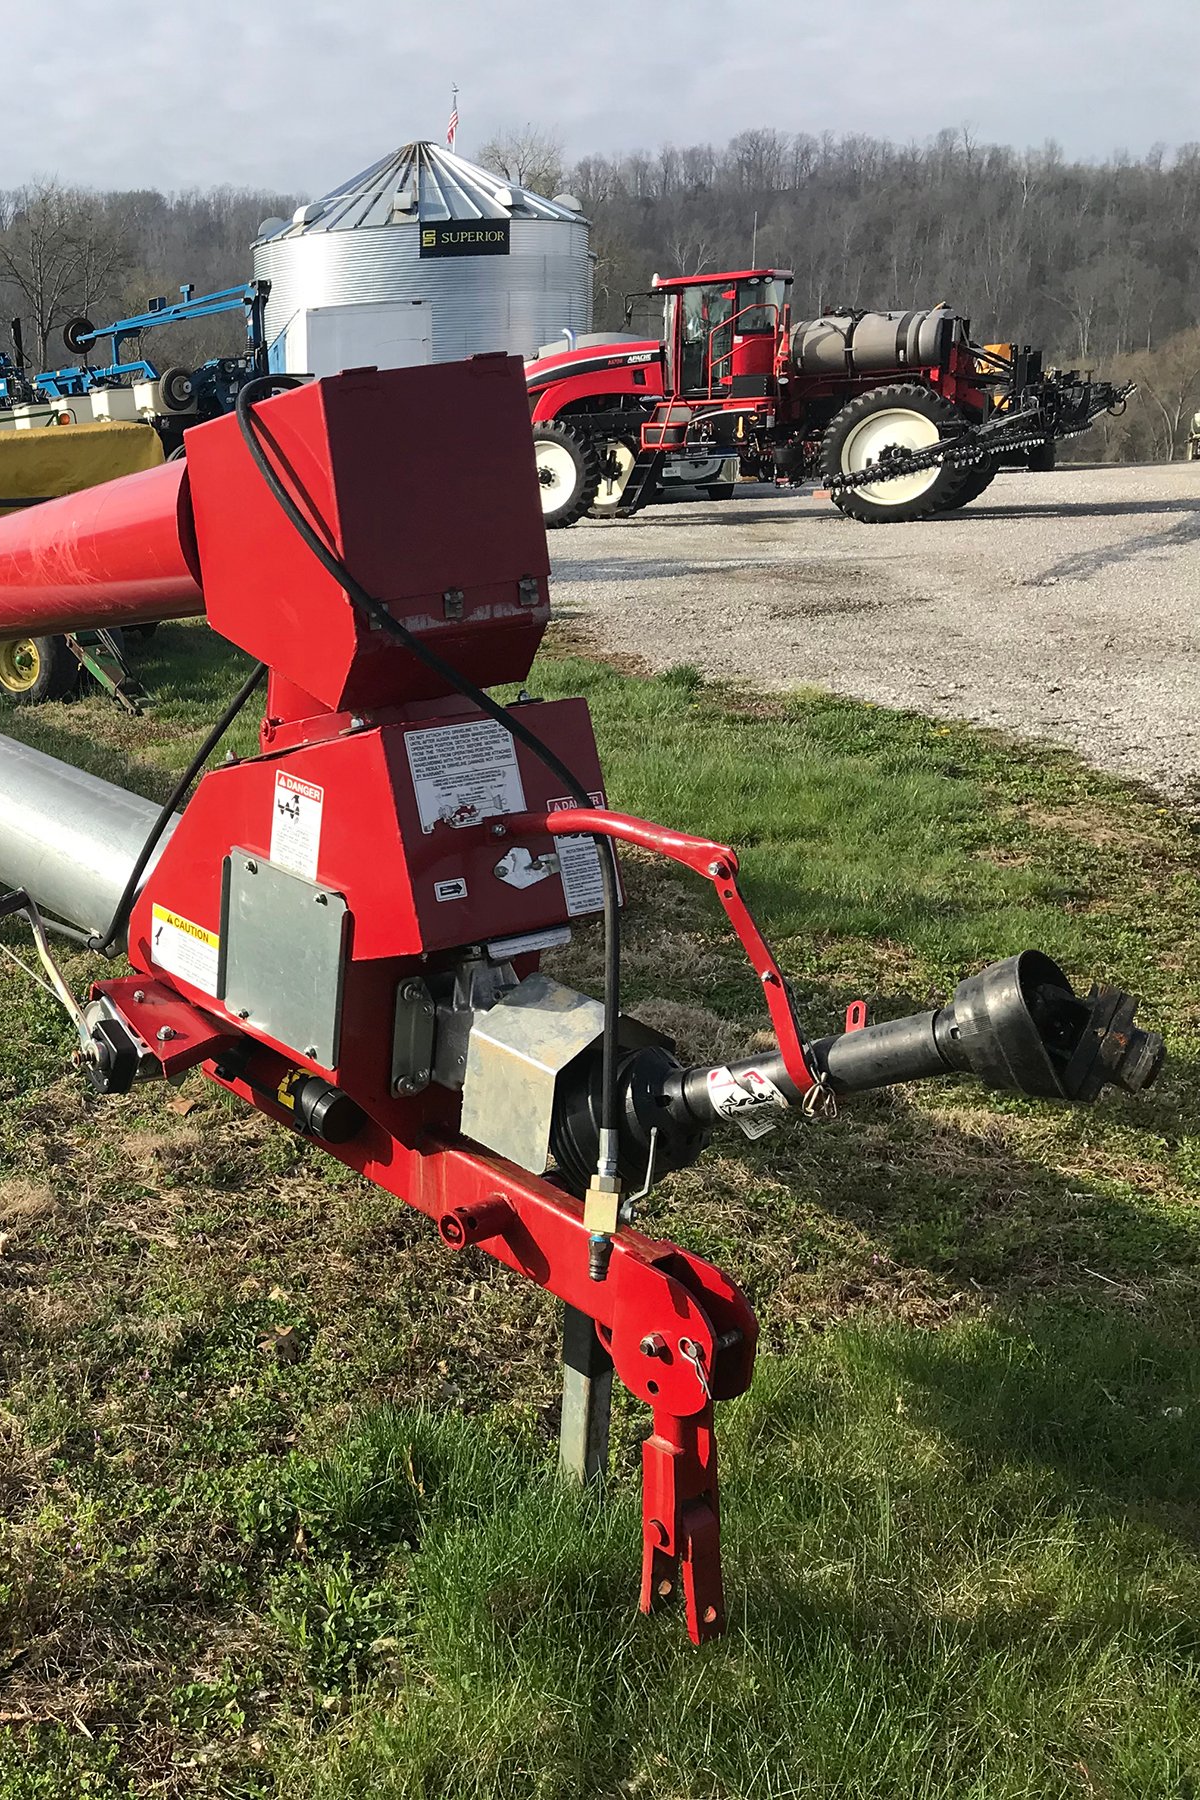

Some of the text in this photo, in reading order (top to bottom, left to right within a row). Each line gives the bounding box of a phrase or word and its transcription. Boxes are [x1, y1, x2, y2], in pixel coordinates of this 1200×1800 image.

[441, 230, 505, 244] SUPERIOR
[627, 353, 652, 364] APACHE
[286, 779, 320, 800] DANGER
[174, 917, 209, 943] CAUTION
